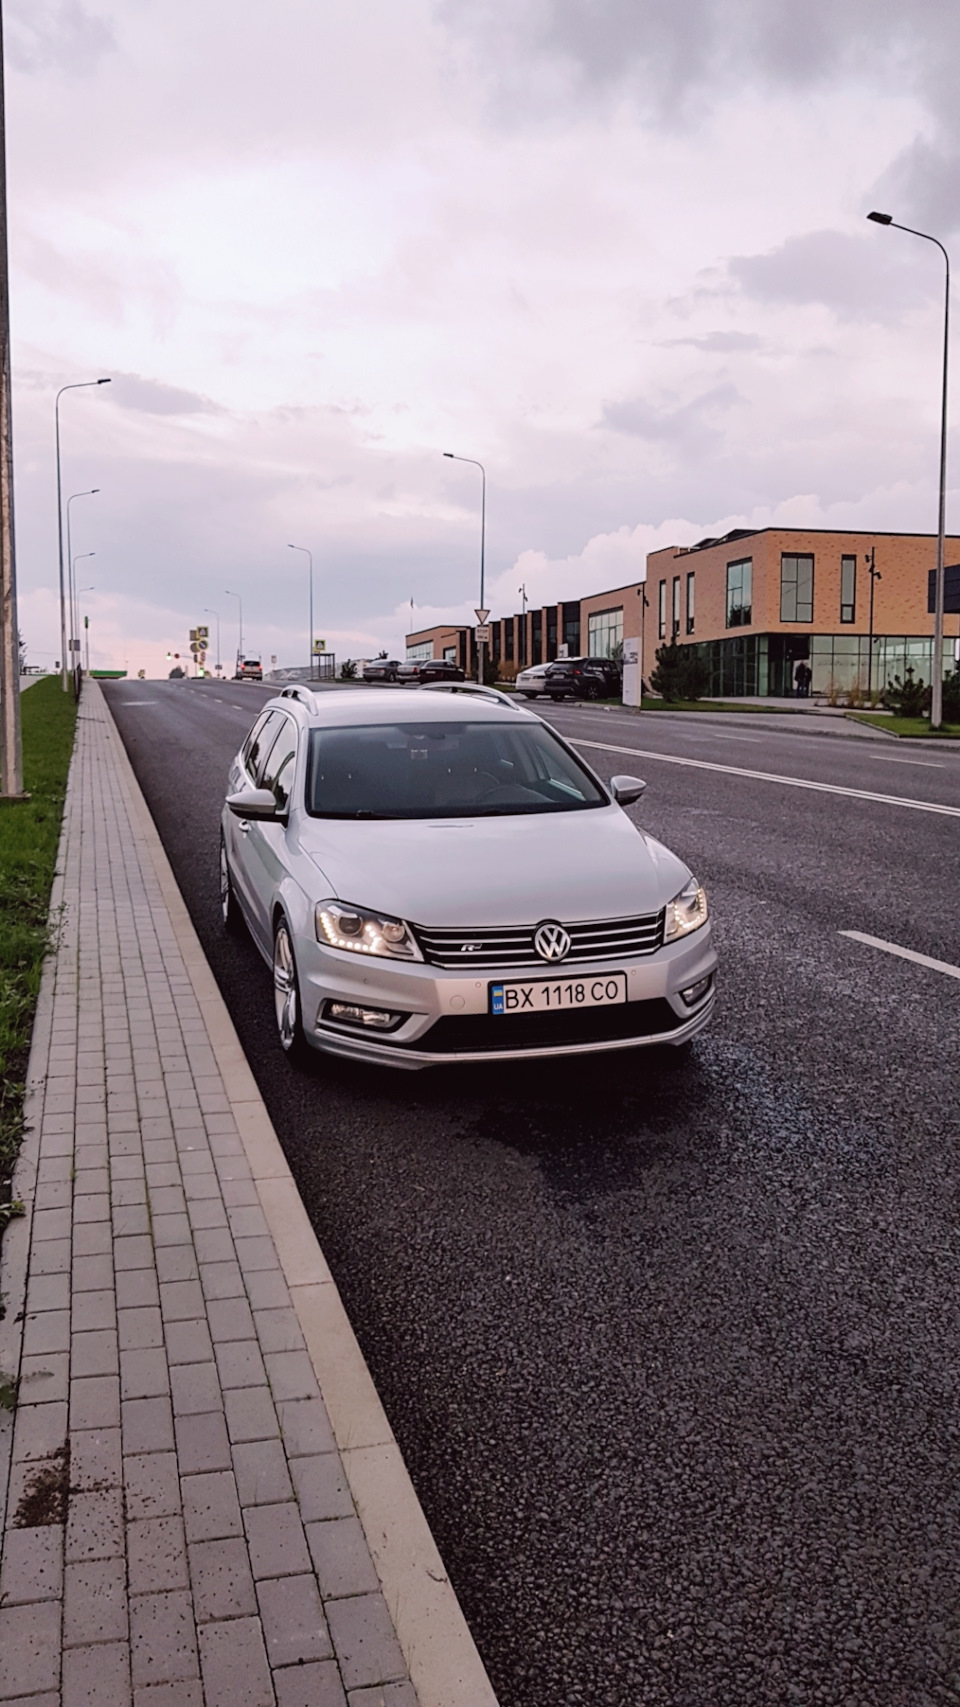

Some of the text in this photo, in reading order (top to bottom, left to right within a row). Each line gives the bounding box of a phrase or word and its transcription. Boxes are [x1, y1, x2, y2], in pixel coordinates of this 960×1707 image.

[536, 924, 570, 961] VW
[505, 980, 618, 1009] BX 1118 CO
